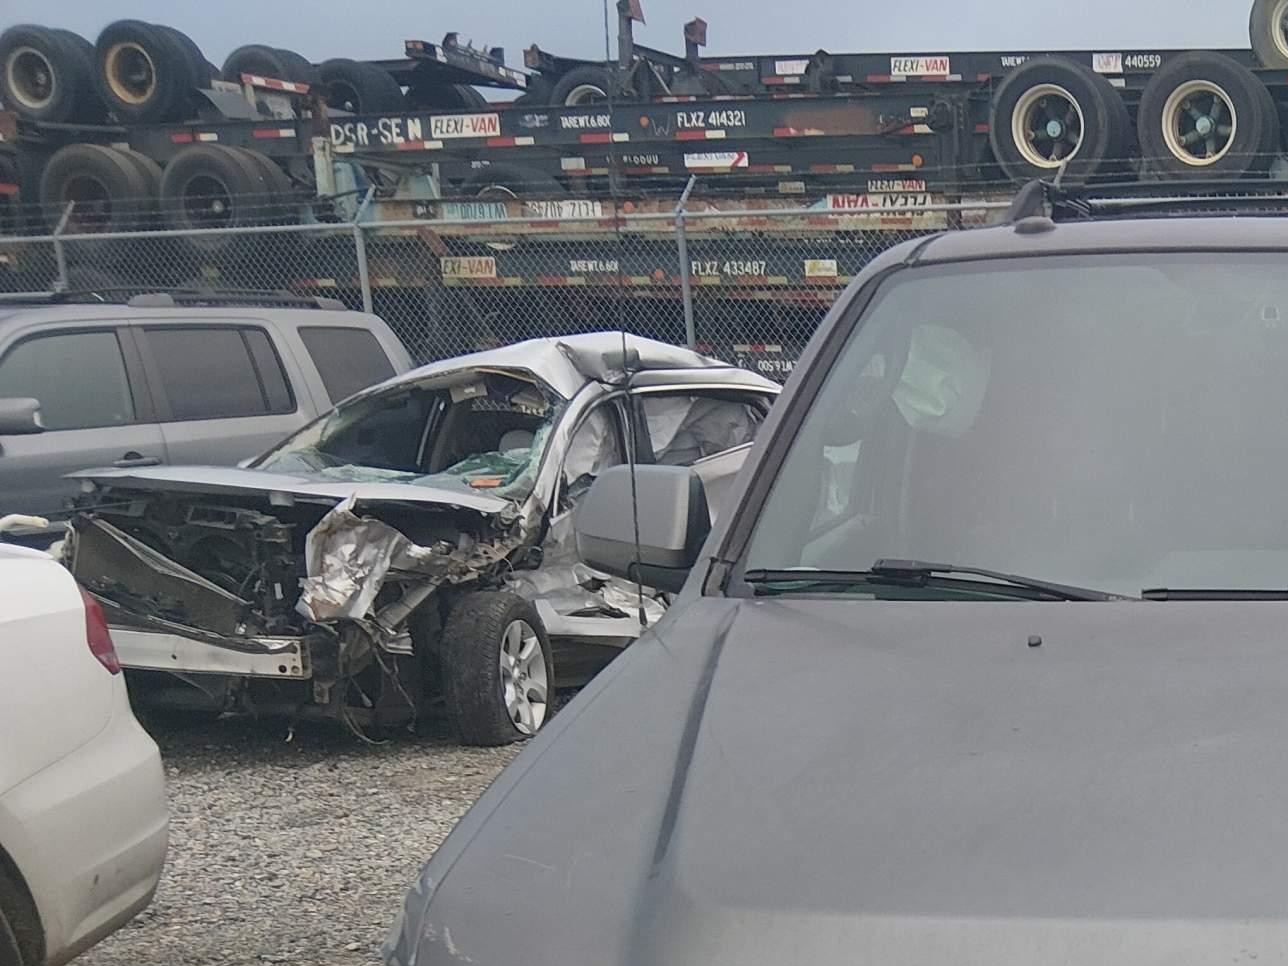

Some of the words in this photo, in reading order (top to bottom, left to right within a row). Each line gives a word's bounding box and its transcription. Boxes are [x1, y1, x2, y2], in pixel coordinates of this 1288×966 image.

[892, 58, 948, 73] FLEXI-VAN
[1125, 55, 1161, 68] 440559
[433, 116, 498, 135] FLEXI-VAN
[677, 111, 705, 127] FLXZ
[708, 110, 746, 127] 414321
[692, 261, 718, 275] FLXZ
[723, 261, 766, 275] 433487
